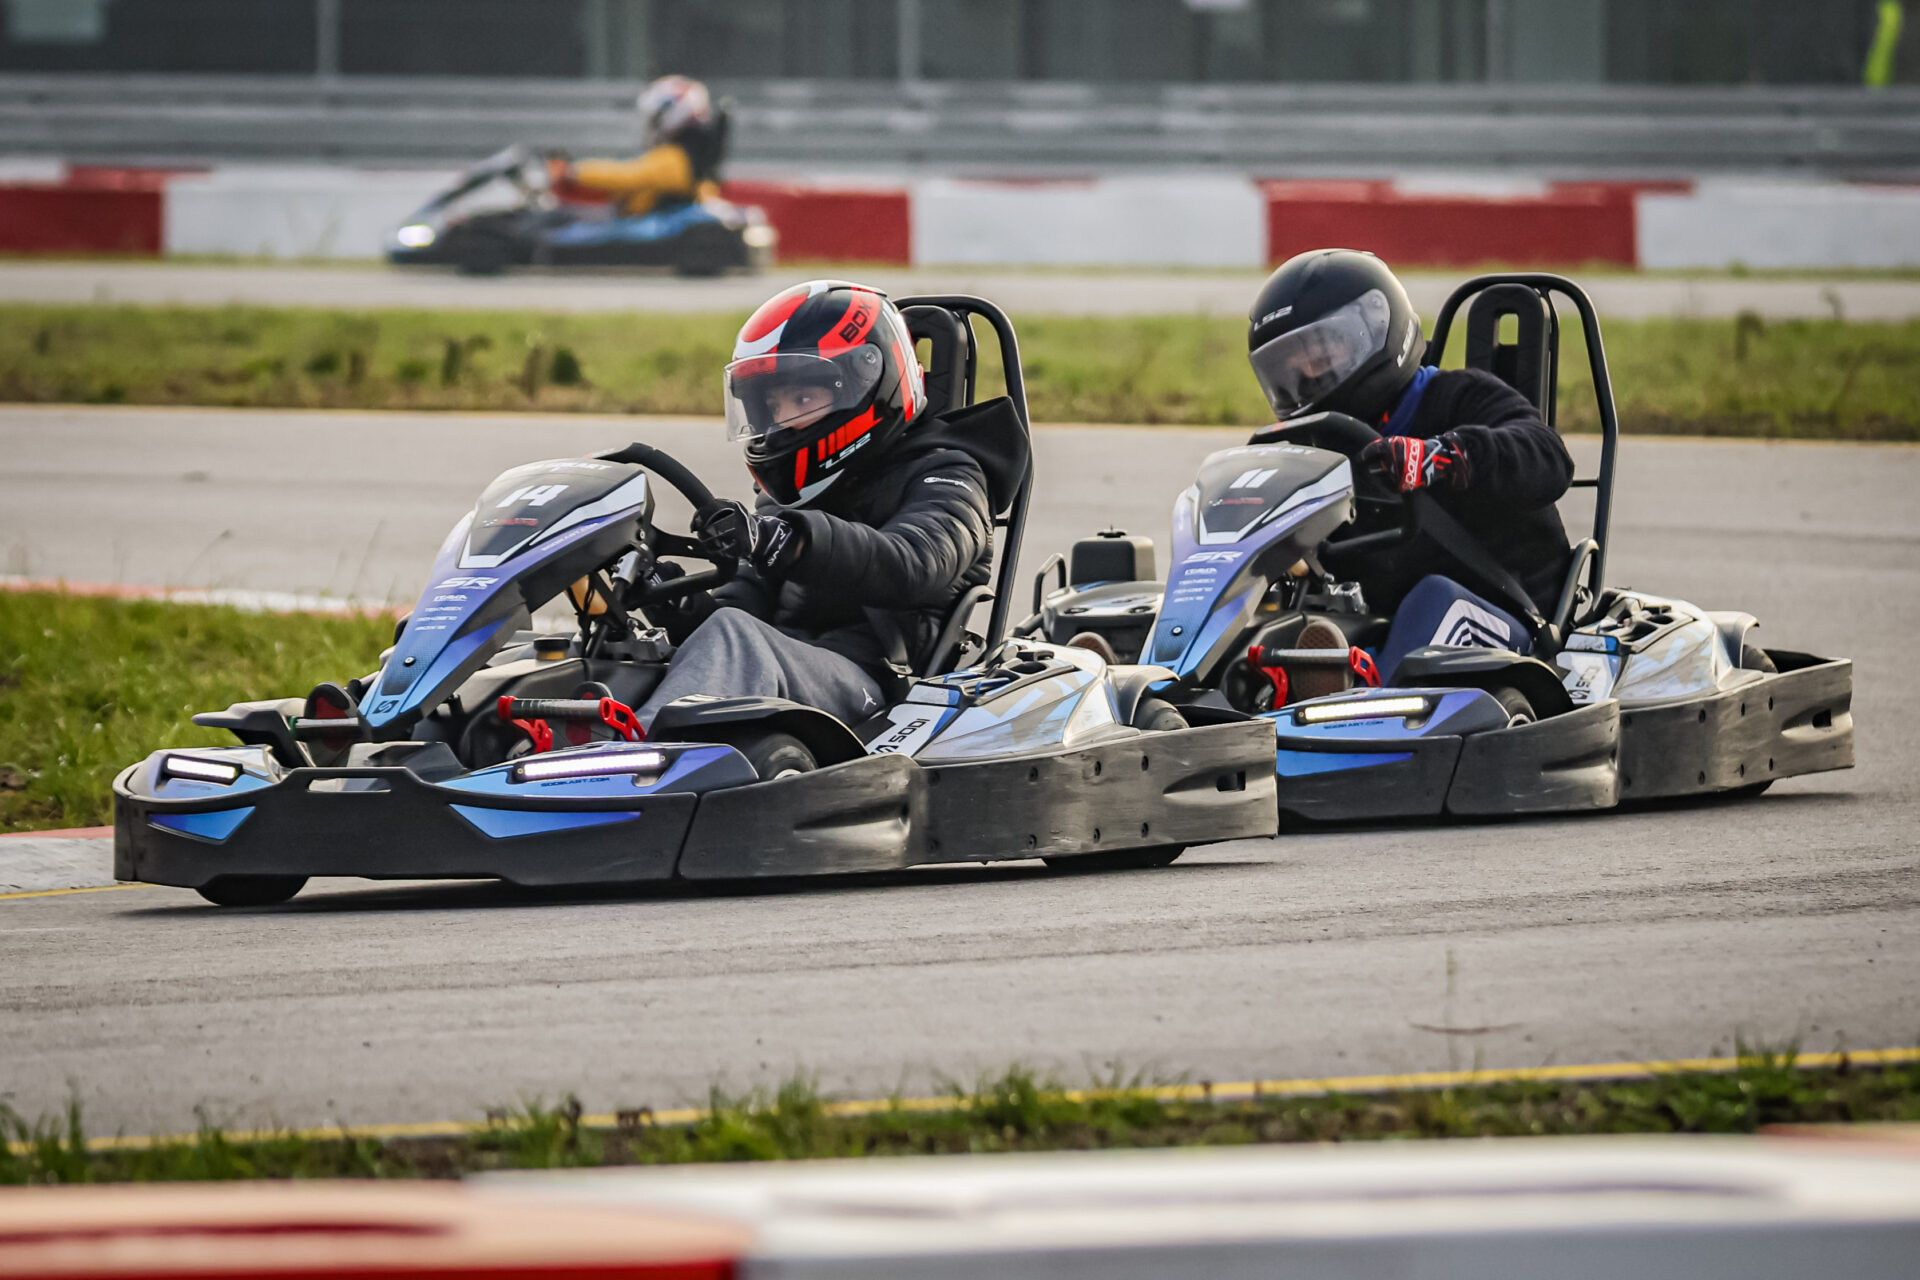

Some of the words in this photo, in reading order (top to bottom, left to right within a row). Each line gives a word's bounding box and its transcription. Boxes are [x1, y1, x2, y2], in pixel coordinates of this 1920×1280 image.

[840, 302, 872, 343] BOX
[1254, 305, 1293, 331] LS2
[1397, 319, 1415, 367] LS2
[825, 432, 871, 469] LS2
[1229, 468, 1280, 489] 11
[496, 484, 569, 508] 14
[1181, 551, 1244, 564] SR
[433, 576, 500, 589] SR
[888, 717, 931, 744] SODI
